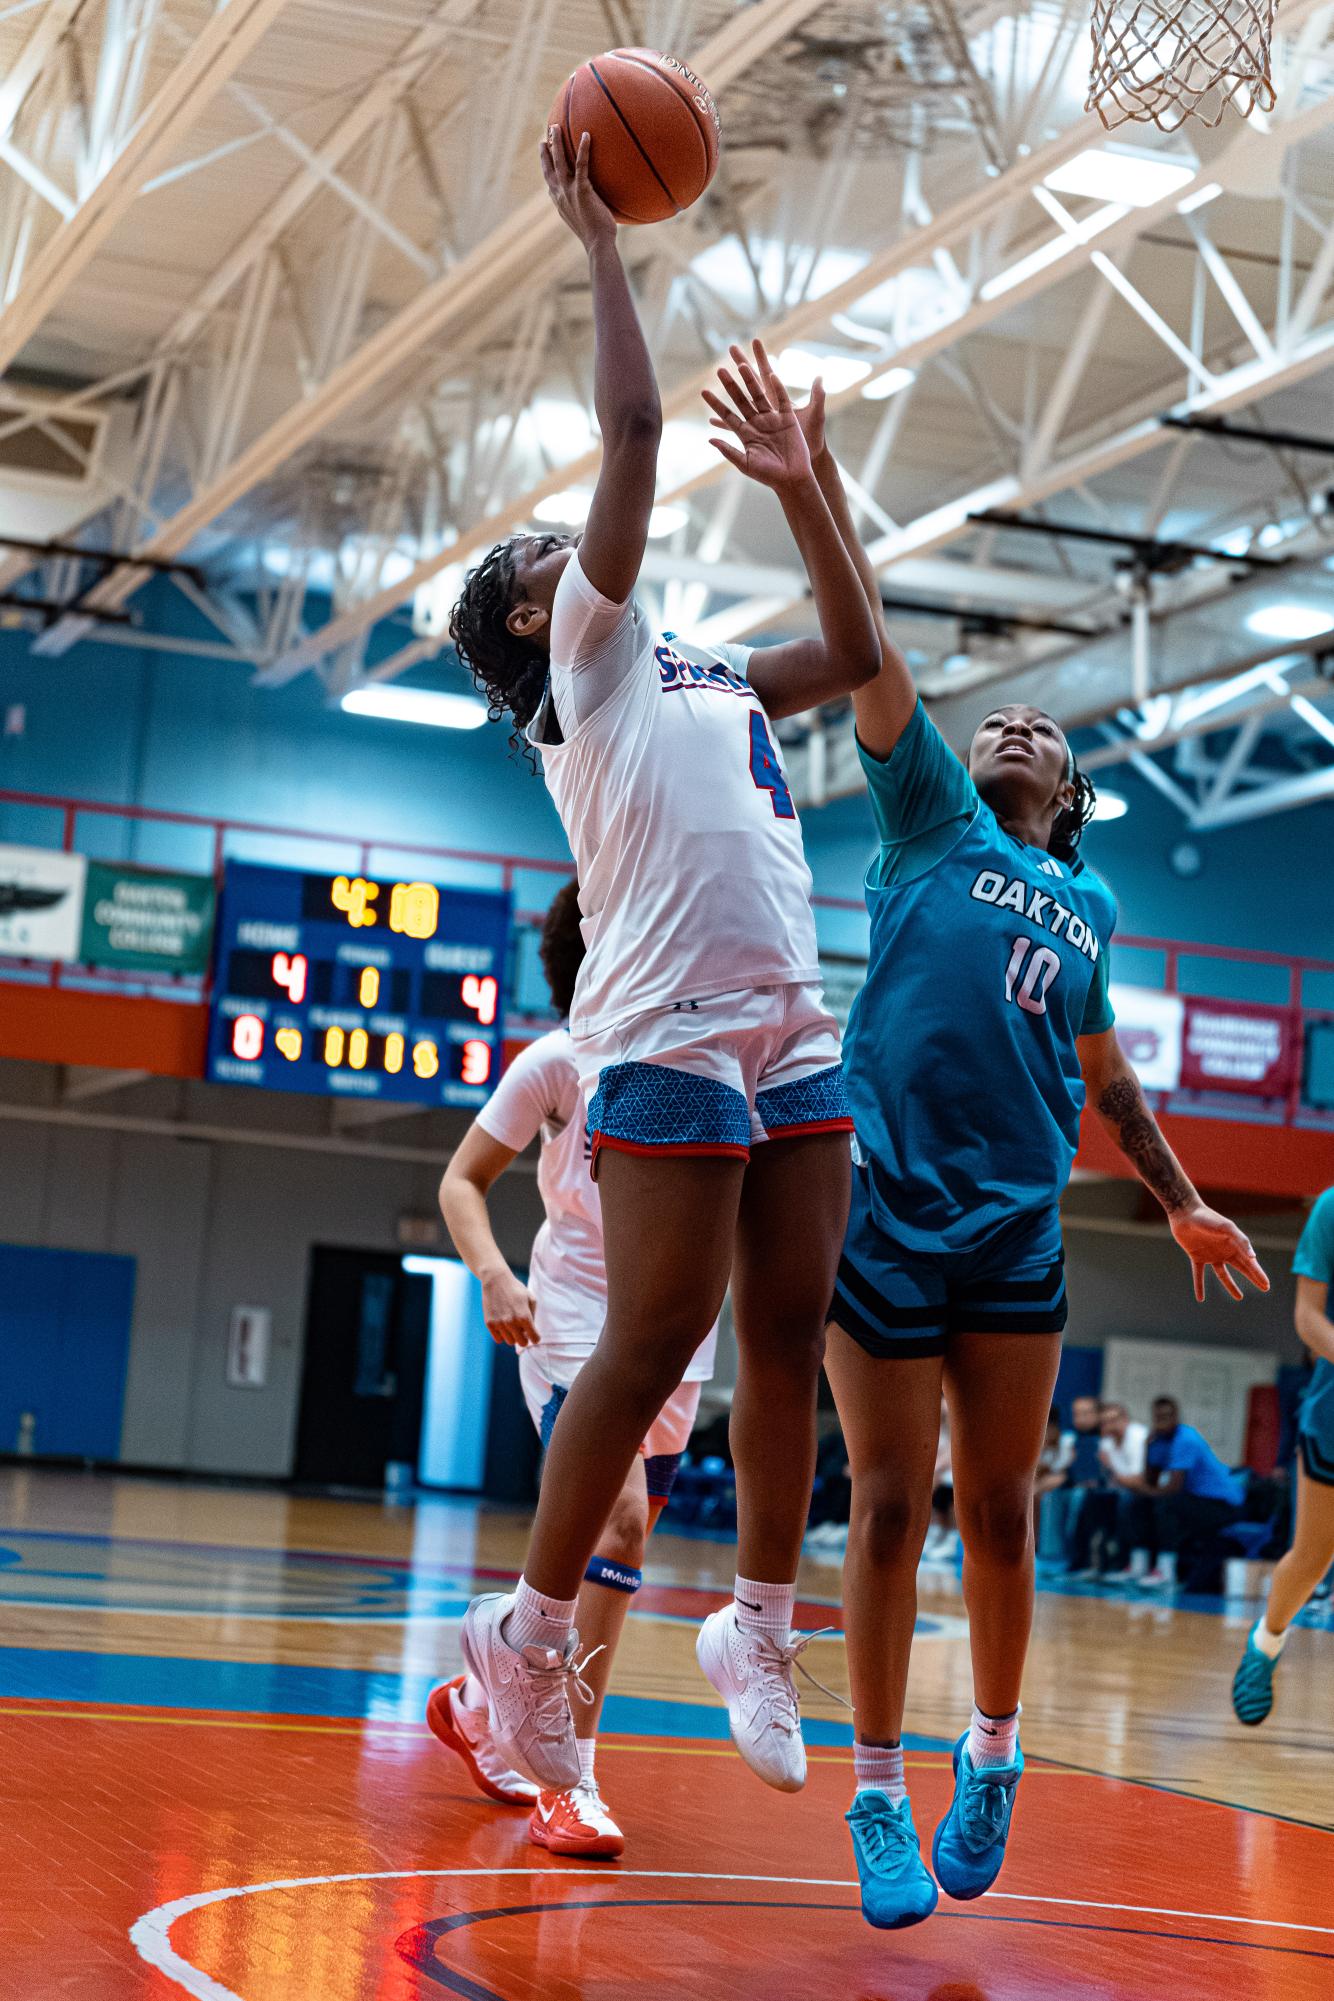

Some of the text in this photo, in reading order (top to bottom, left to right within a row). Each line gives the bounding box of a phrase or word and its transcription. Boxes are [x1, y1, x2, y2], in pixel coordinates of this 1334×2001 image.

[749, 709, 795, 819] 4
[970, 868, 1099, 963] OAKTON
[272, 951, 308, 1004] 4
[360, 966, 380, 1008] 1
[462, 974, 497, 1025] 4
[1004, 935, 1061, 1015] 10
[233, 1014, 264, 1060] 0
[461, 1039, 492, 1085] 3
